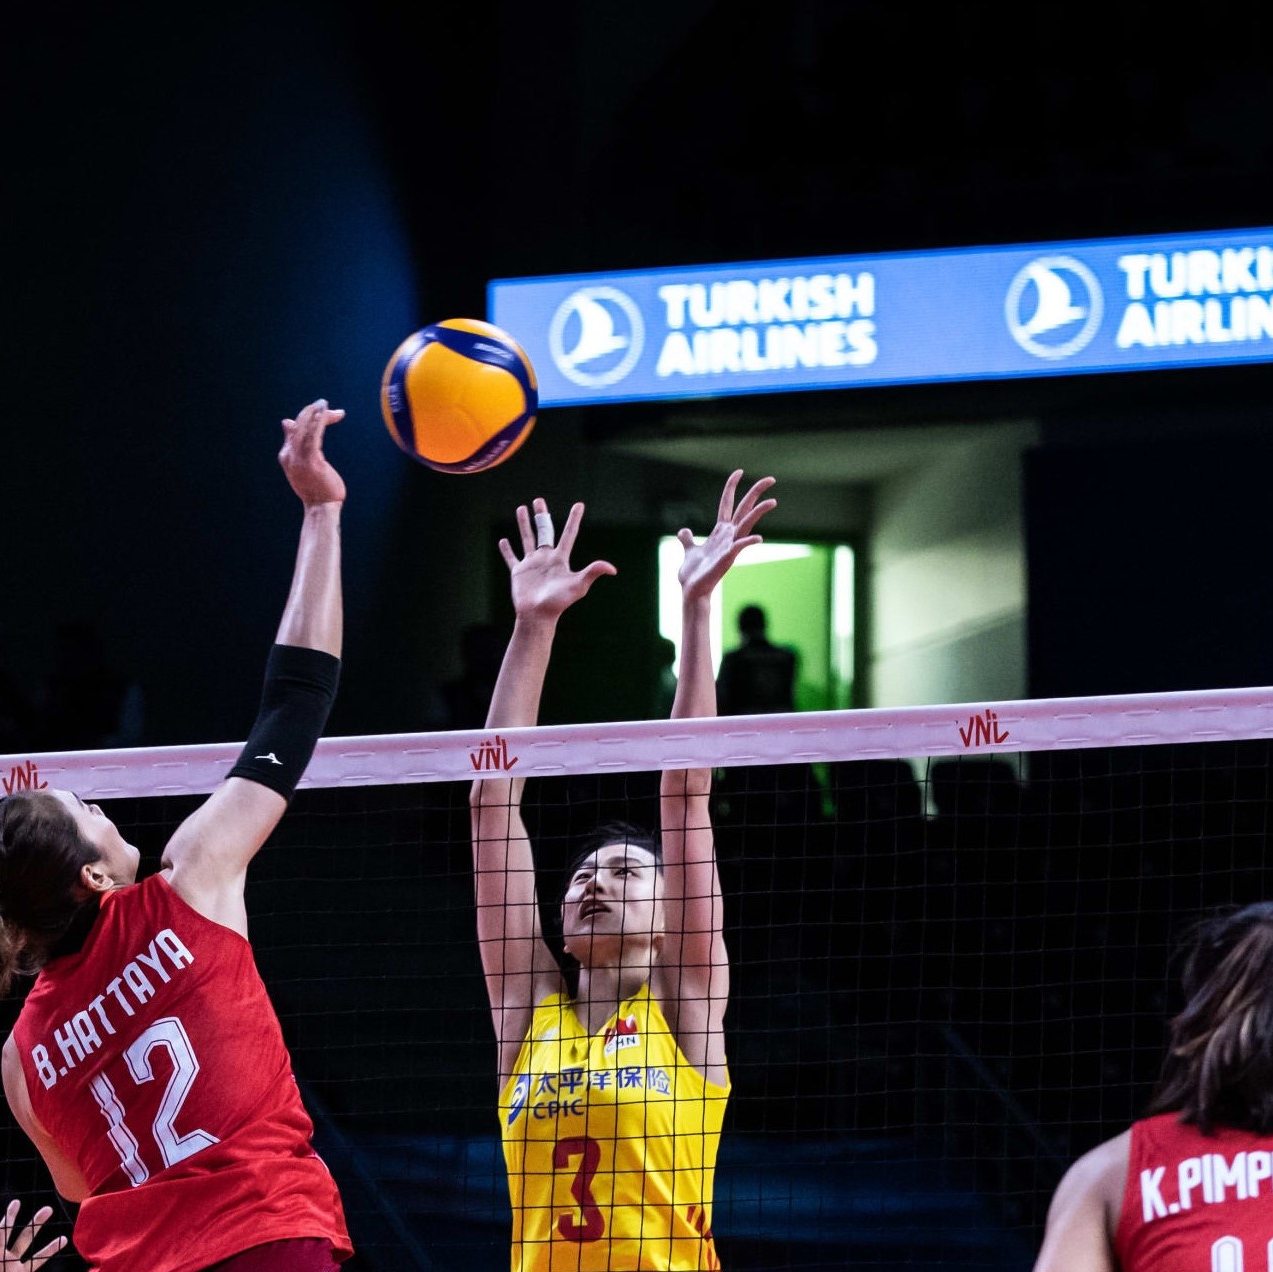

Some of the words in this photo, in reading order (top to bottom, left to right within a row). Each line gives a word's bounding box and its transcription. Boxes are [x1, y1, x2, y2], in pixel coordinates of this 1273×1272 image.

[658, 272, 876, 329] TURKISH
[656, 318, 878, 378] AIRLINES
[31, 928, 194, 1090] B.HATTAYA
[88, 1016, 220, 1188] 12
[533, 1098, 584, 1120] CPIC
[552, 1136, 605, 1243] 3
